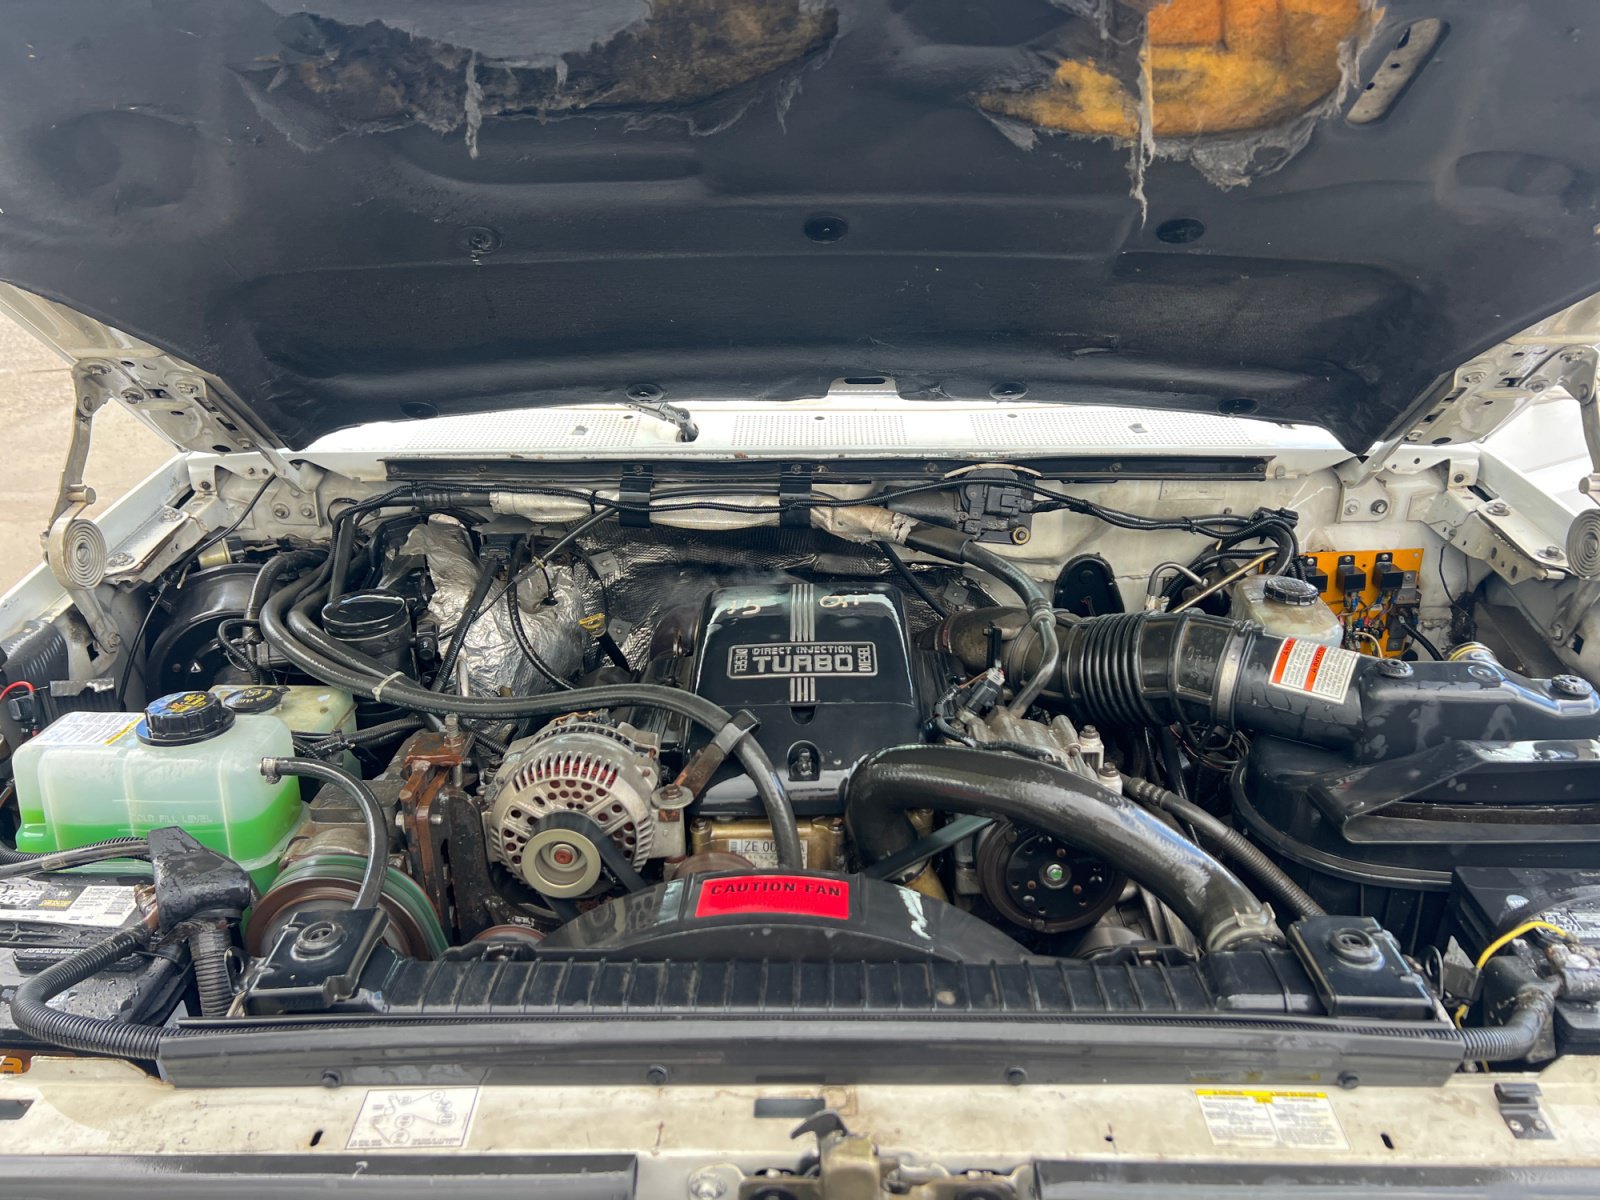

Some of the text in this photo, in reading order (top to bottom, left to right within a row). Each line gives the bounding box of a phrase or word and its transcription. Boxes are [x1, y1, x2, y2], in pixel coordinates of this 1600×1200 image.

[752, 645, 853, 656] DIRECT INJECTION
[735, 648, 748, 673] DIESEL
[752, 654, 853, 673] TURBO
[858, 645, 872, 672] DIESEL
[159, 815, 178, 824] FILL
[182, 815, 212, 824] LEVEL
[744, 841, 758, 852] ZE
[711, 882, 841, 896] CAUTION FAN
